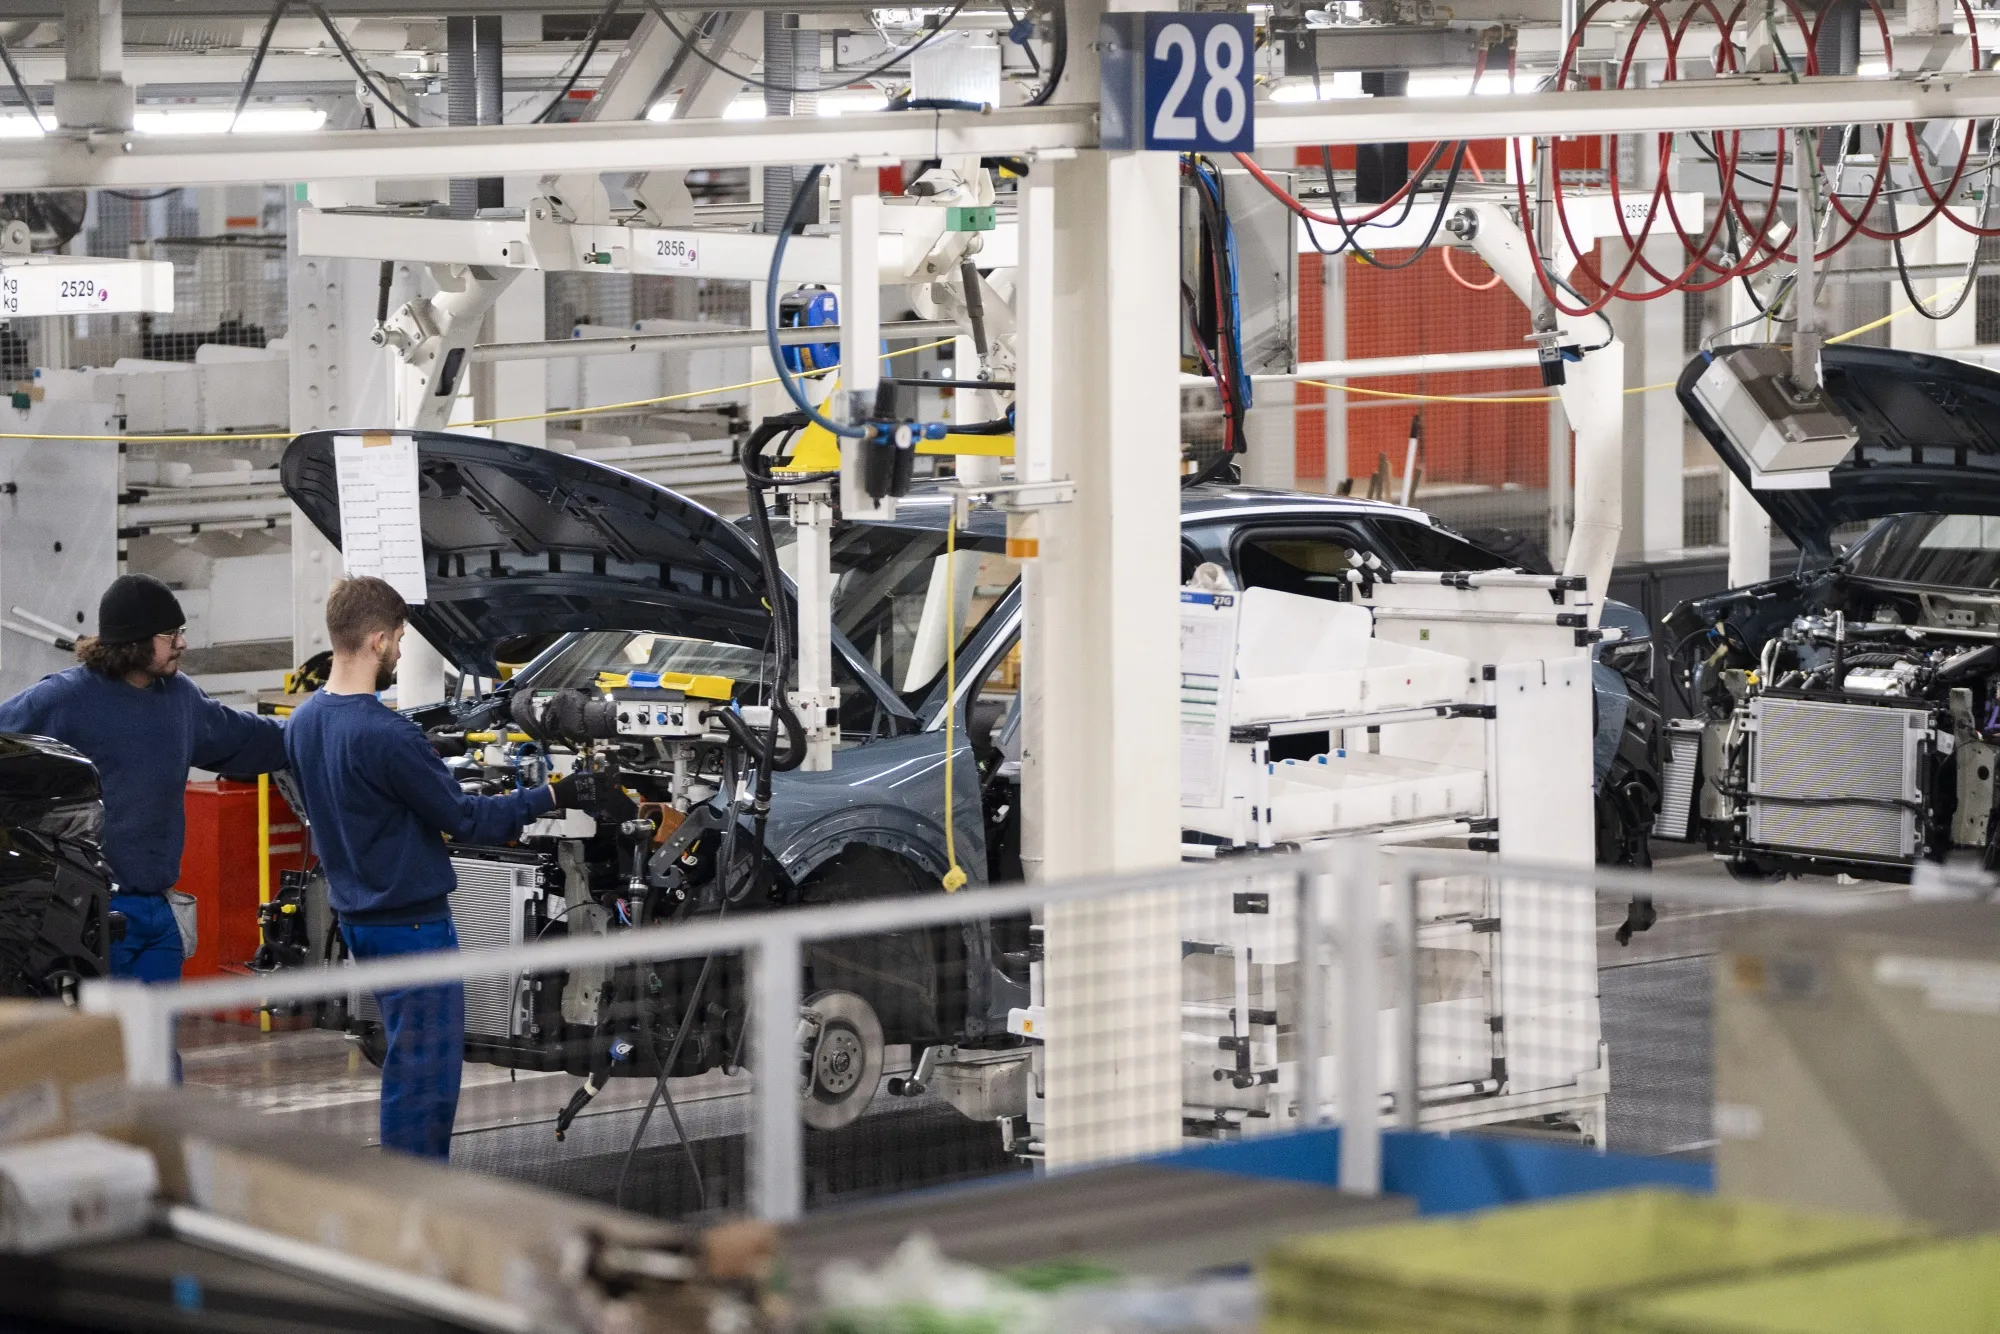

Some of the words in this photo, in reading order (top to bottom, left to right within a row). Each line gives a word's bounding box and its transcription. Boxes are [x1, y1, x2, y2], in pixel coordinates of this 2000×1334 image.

[1152, 23, 1246, 143] 28
[1625, 204, 1649, 219] 2856
[657, 240, 685, 256] 2856
[3, 276, 18, 294] kg
[61, 280, 94, 298] 2529
[3, 295, 18, 312] kg
[1213, 596, 1232, 606] 27G
